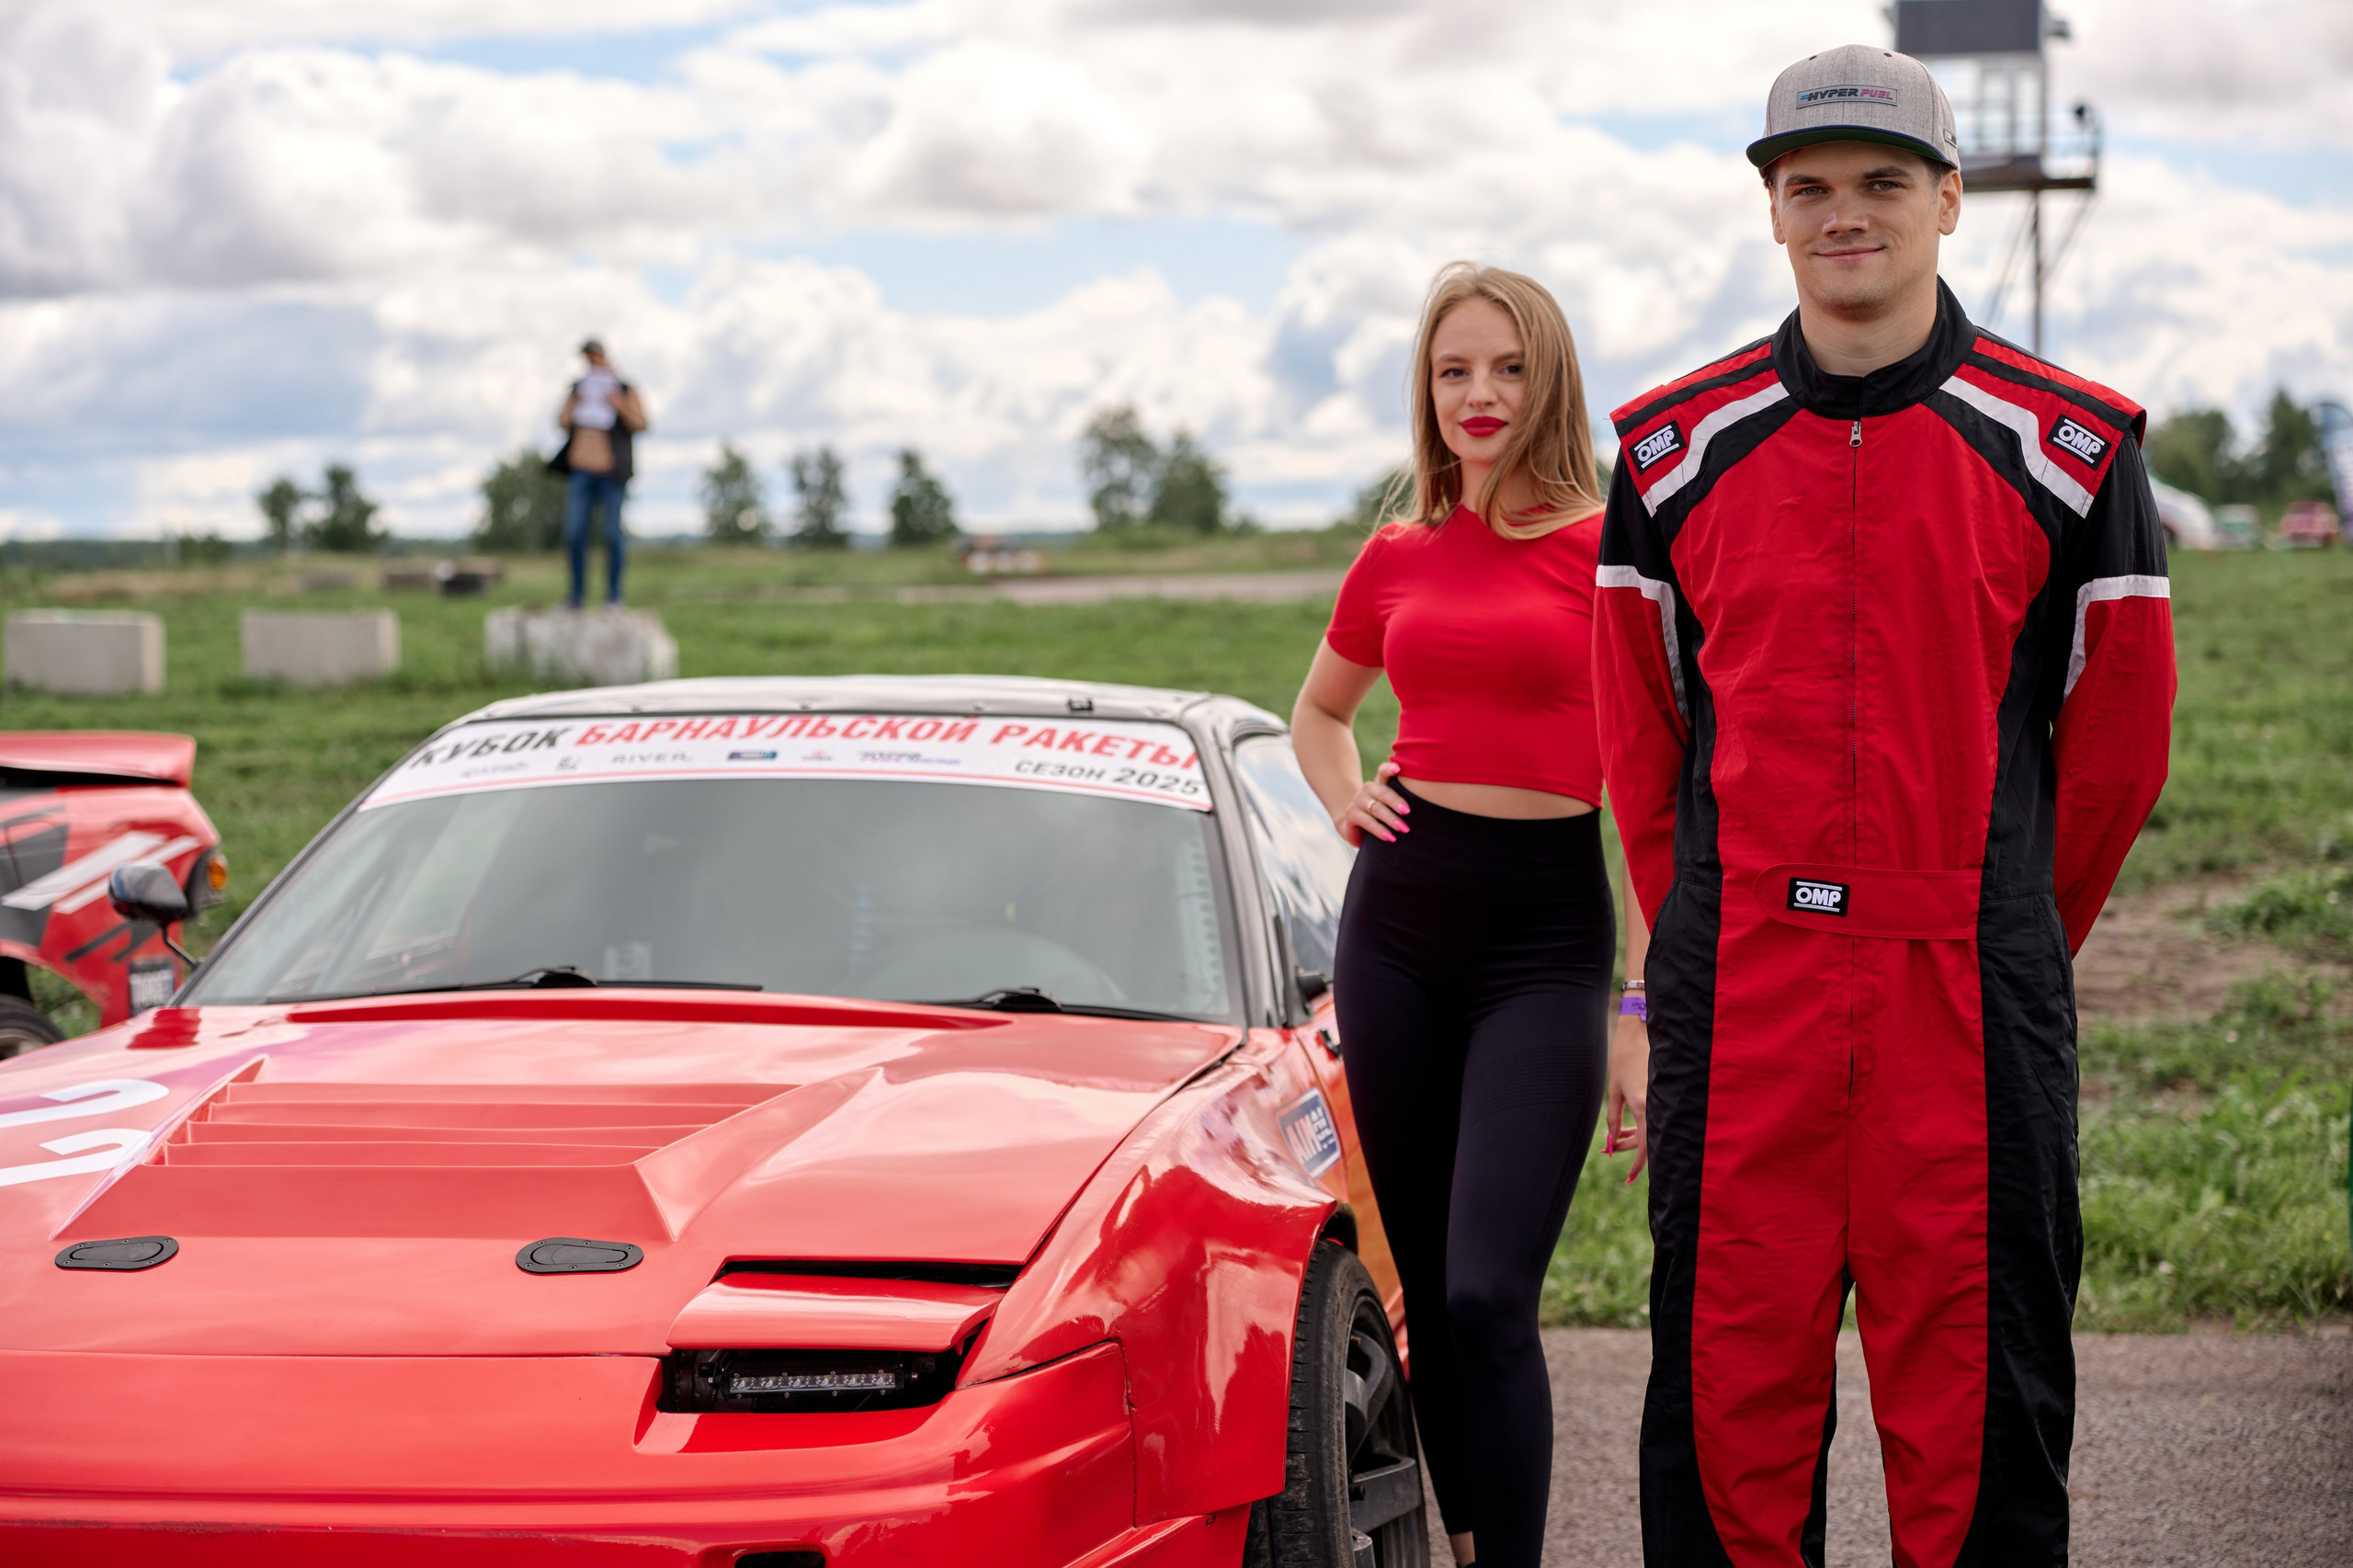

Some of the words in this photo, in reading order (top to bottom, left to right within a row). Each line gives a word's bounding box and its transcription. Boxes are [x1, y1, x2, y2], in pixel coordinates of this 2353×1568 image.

[1808, 88, 1859, 101] HYPER
[1860, 89, 1893, 100] FUEL
[1637, 429, 1675, 462] OMP
[2058, 426, 2101, 455] OMP
[411, 724, 573, 769] КУБОК
[574, 715, 981, 746] БАРНАУЛЬСКОЙ
[990, 724, 1199, 769] РАКЕТЫ
[1015, 760, 1106, 781] СЕЗОН
[1113, 767, 1203, 795] 2025
[1795, 887, 1841, 907] OMP
